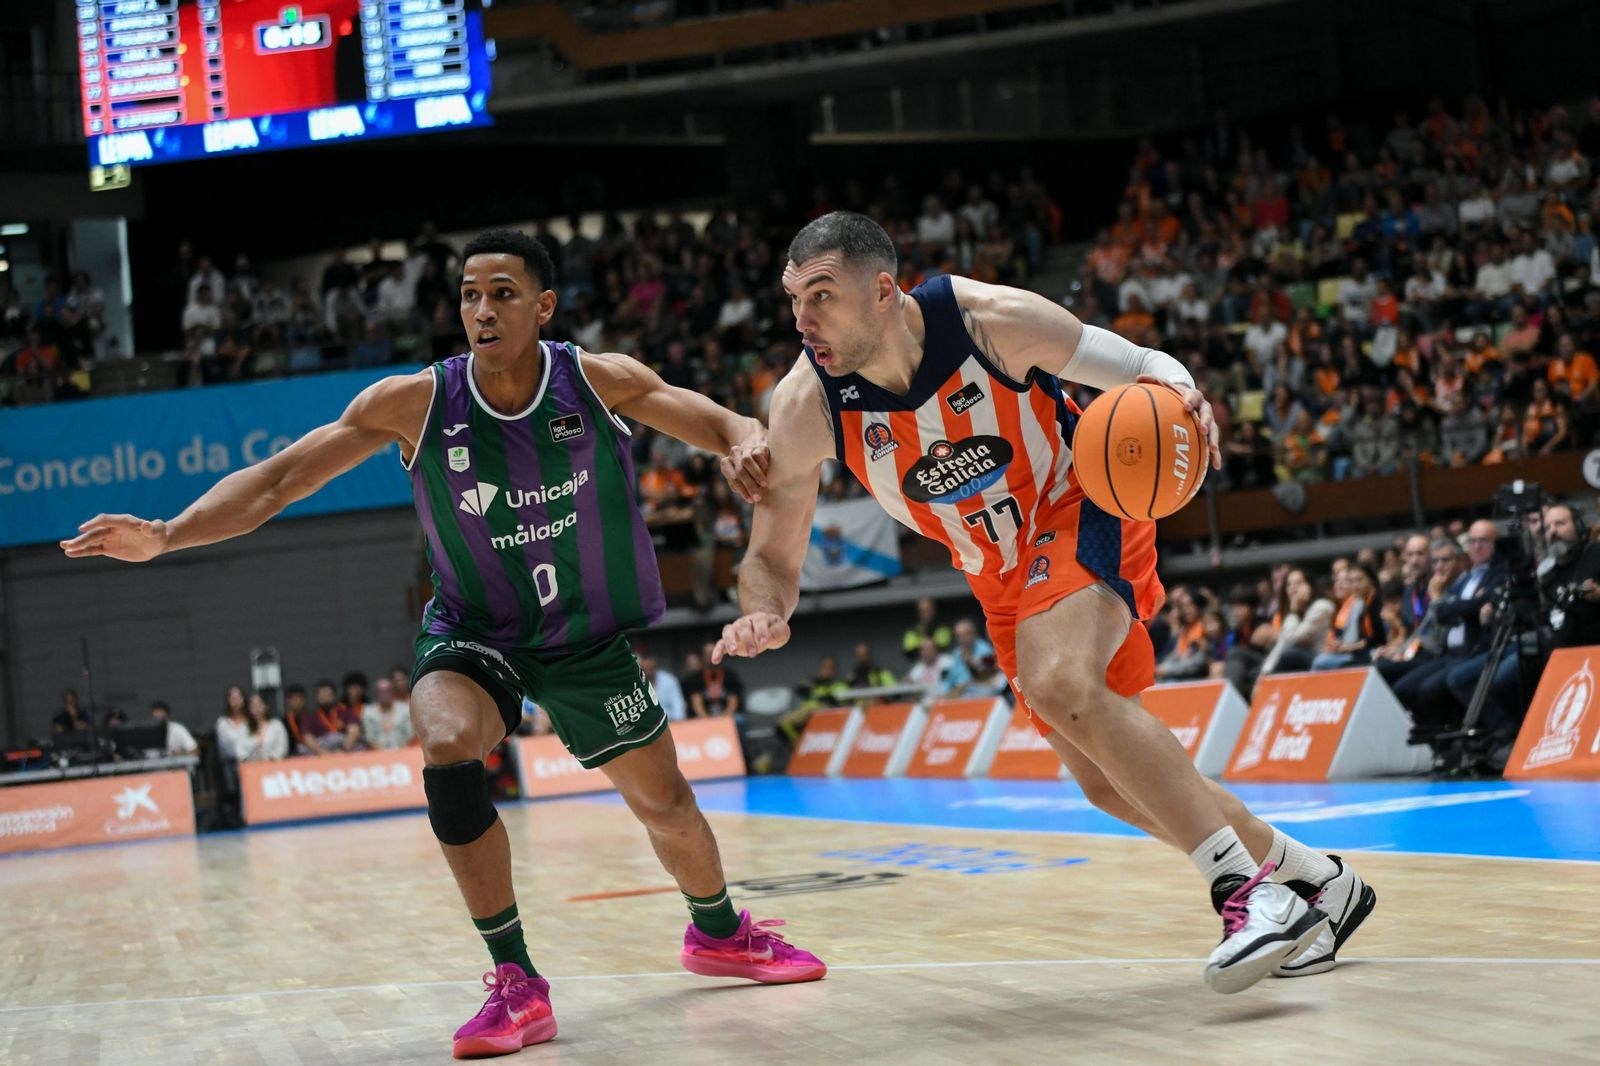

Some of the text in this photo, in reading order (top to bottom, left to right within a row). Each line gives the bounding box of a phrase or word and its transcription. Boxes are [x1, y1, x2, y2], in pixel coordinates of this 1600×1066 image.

[957, 393, 983, 412] endesa
[555, 427, 582, 439] endesa
[1172, 424, 1190, 480] EVO
[178, 433, 230, 477] da
[916, 445, 991, 487] Estrella
[505, 470, 589, 509] Unicaja
[927, 458, 997, 495] Galicia
[962, 495, 1024, 544] 77
[532, 563, 559, 607] 0
[609, 699, 649, 729] laga
[613, 682, 645, 714] má
